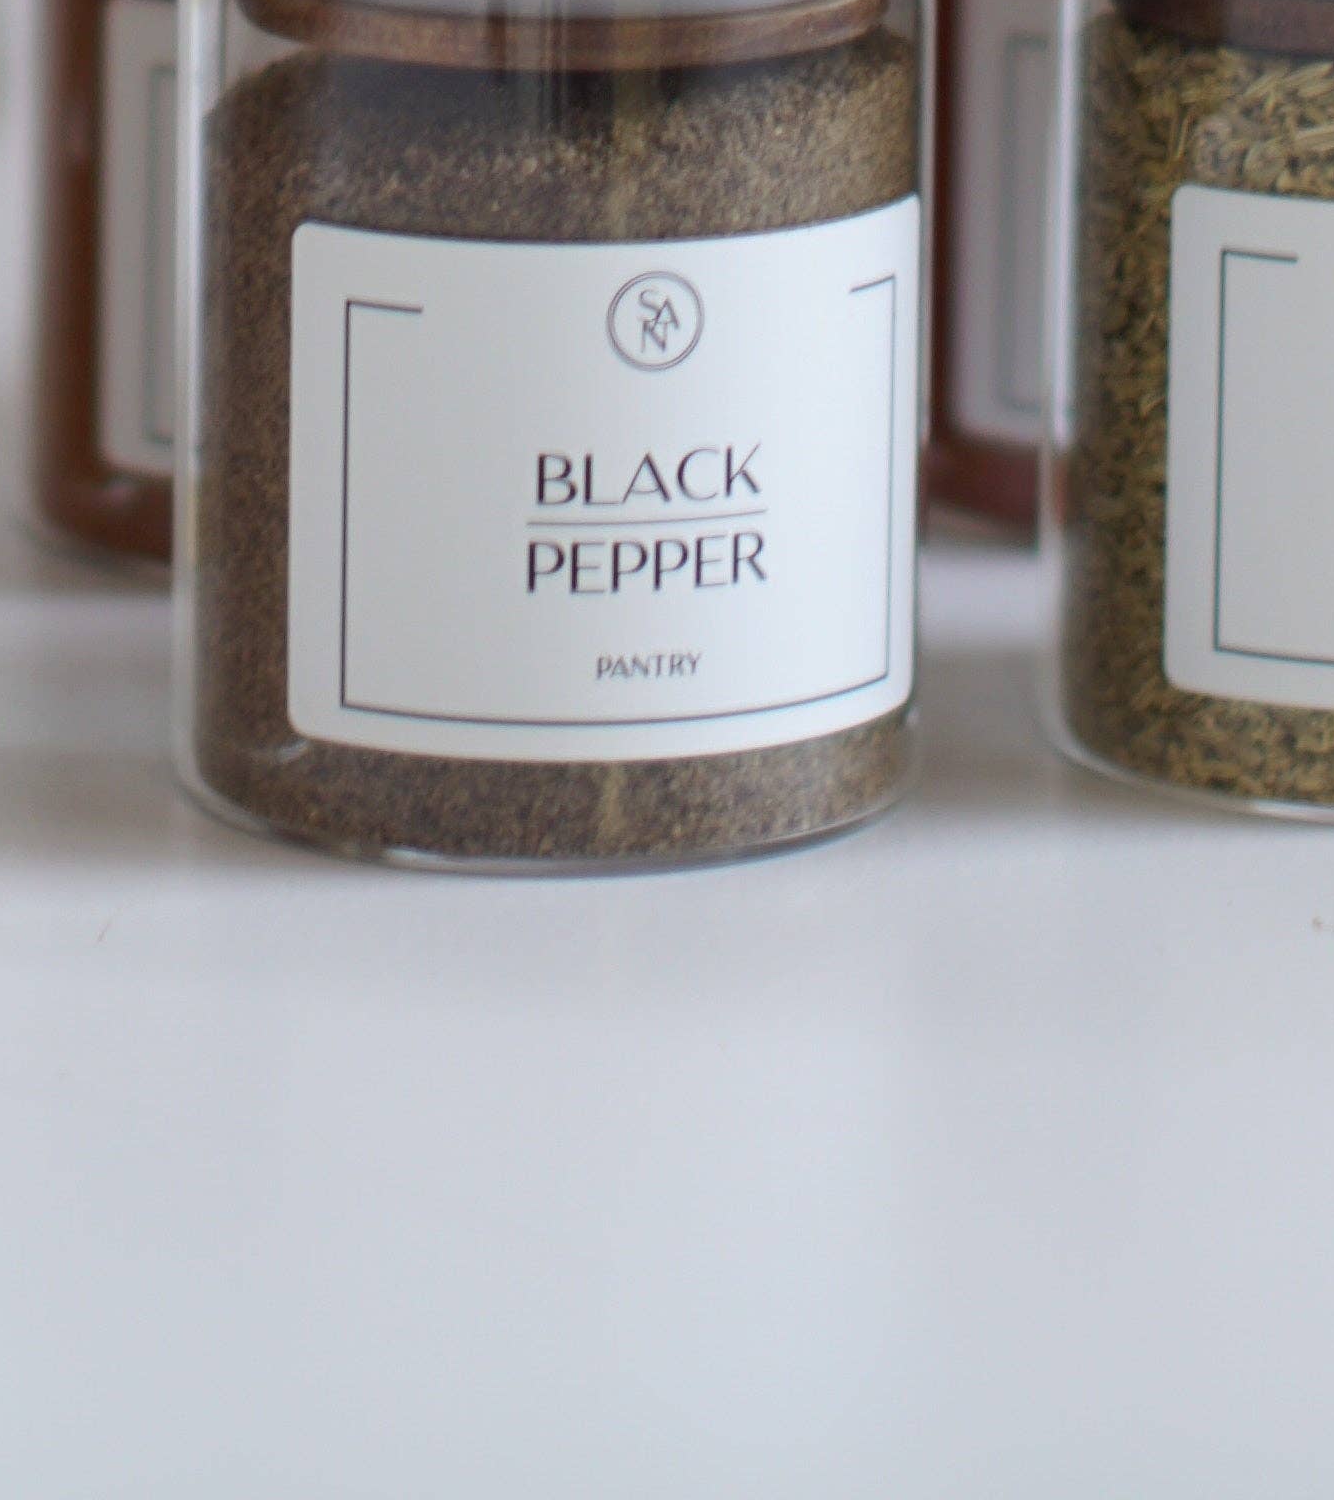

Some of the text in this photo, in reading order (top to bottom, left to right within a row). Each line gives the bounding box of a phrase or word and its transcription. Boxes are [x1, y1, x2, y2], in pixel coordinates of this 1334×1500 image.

[534, 443, 764, 506] BLACK
[526, 531, 768, 595] PEPPER
[596, 651, 703, 681] PANTRY
